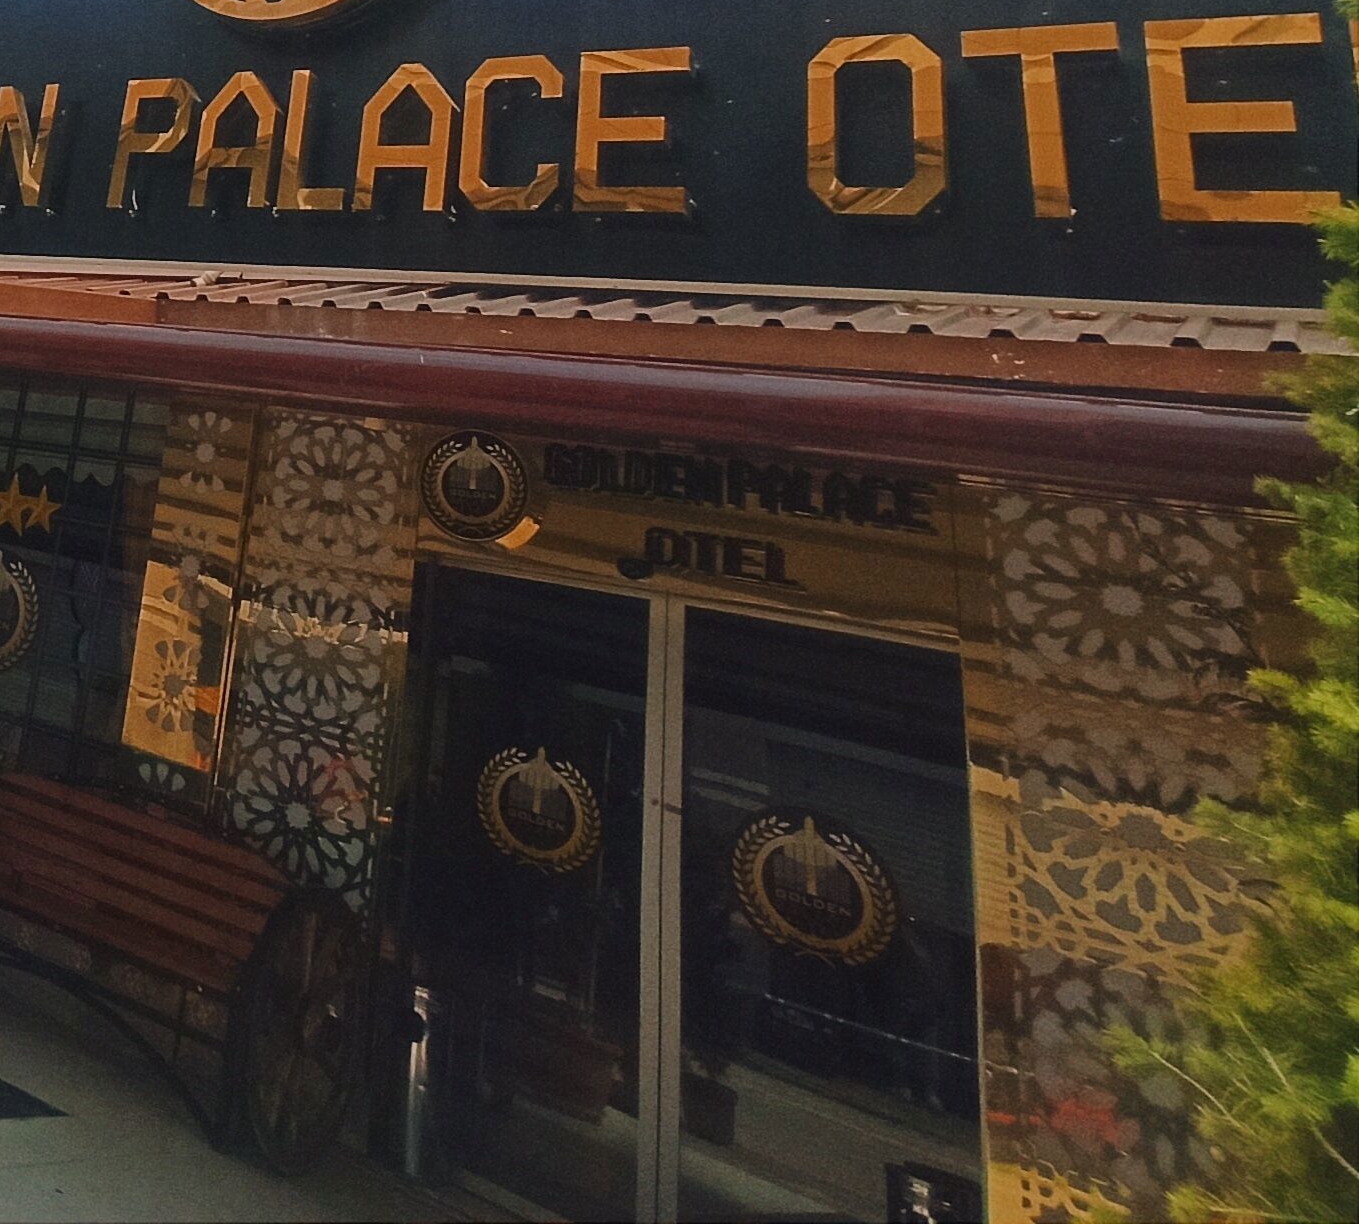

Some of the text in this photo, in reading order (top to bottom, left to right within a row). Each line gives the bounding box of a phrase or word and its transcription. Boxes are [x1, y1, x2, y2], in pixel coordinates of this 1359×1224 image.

[106, 46, 692, 212] PALACE
[807, 12, 1359, 225] OTE
[644, 526, 805, 591] OTEL
[774, 888, 851, 917] GOLDEN
